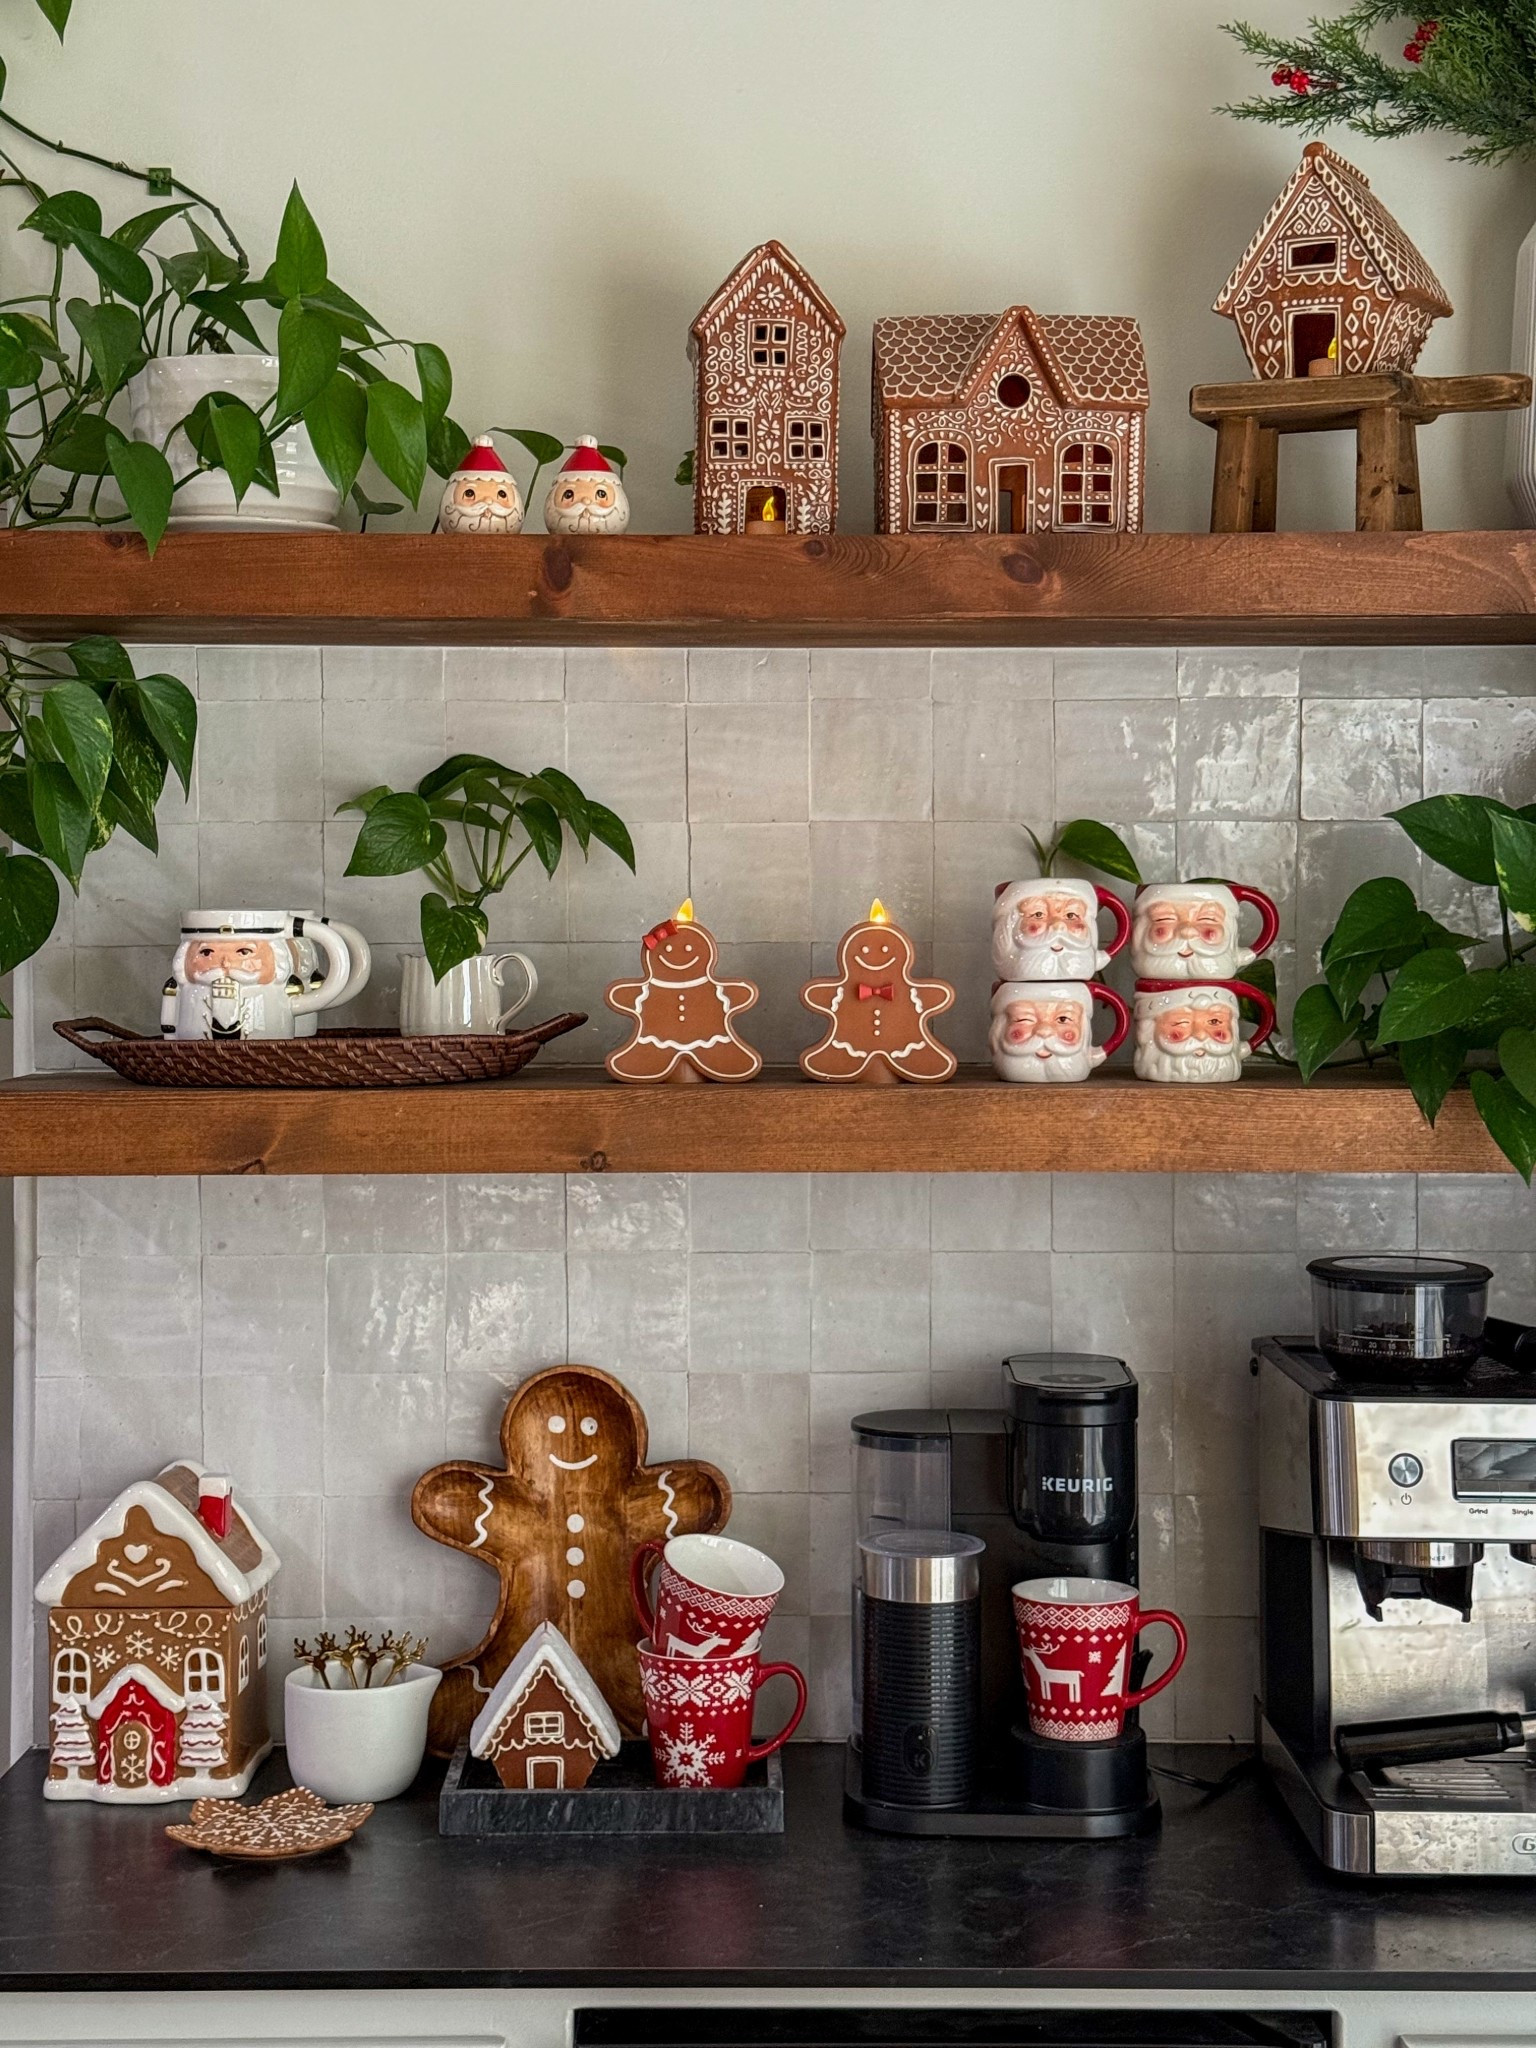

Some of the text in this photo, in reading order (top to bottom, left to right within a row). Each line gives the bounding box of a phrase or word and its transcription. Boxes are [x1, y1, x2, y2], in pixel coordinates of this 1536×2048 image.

[1041, 1476, 1113, 1493] KEURIG
[1468, 1507, 1534, 1516] Grind Single
